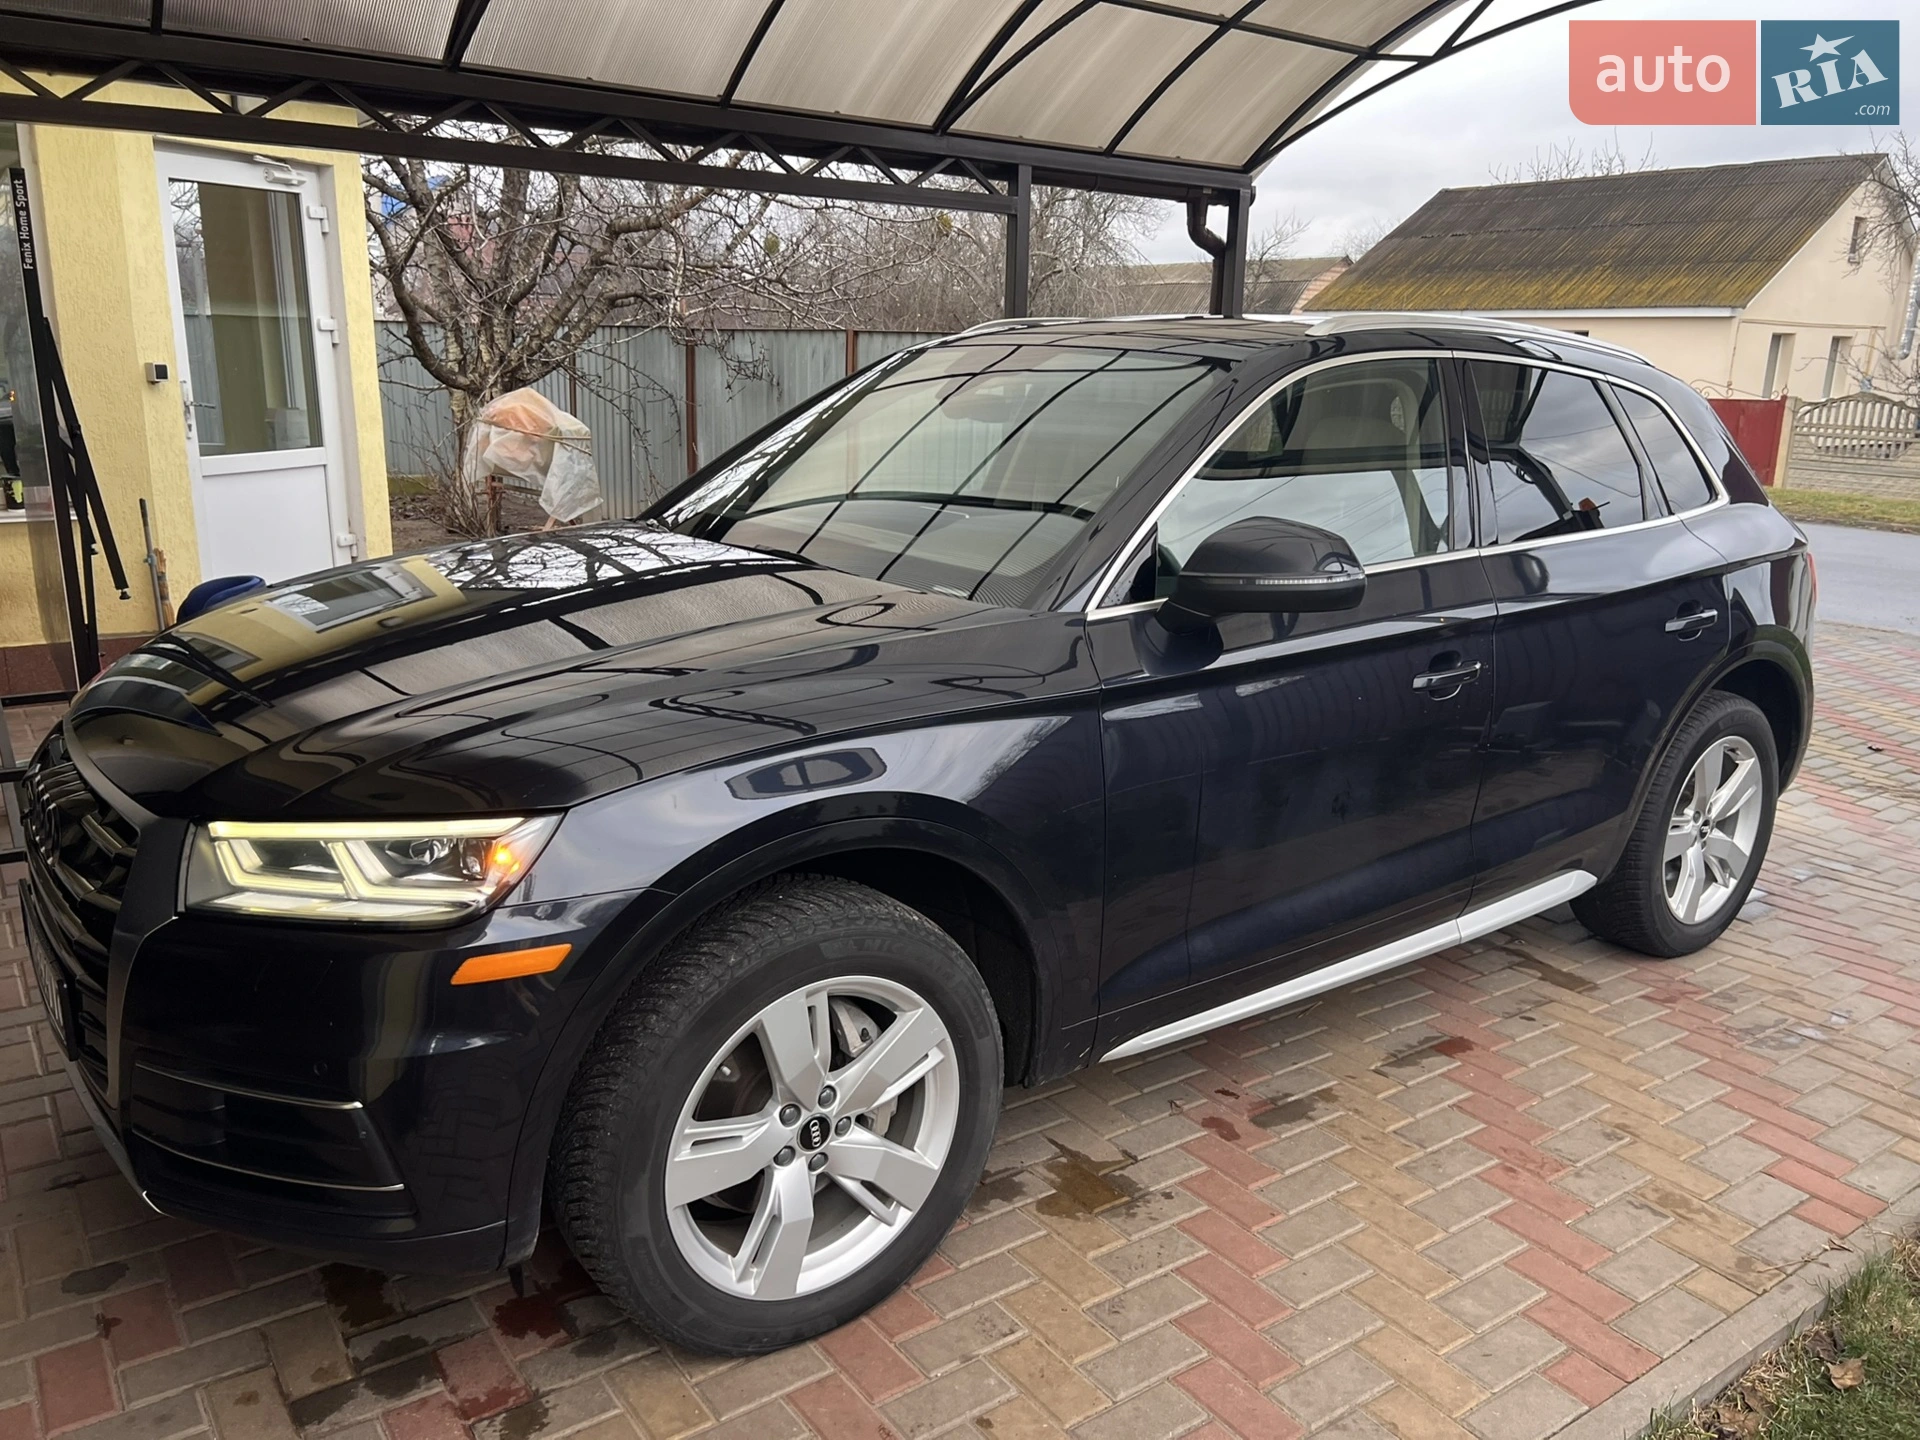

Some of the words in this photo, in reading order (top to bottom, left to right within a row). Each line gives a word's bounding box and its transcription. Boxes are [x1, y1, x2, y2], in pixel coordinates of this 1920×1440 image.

[13, 179, 28, 208] Sport
[19, 210, 30, 239] Home
[21, 242, 34, 270] Fenix
